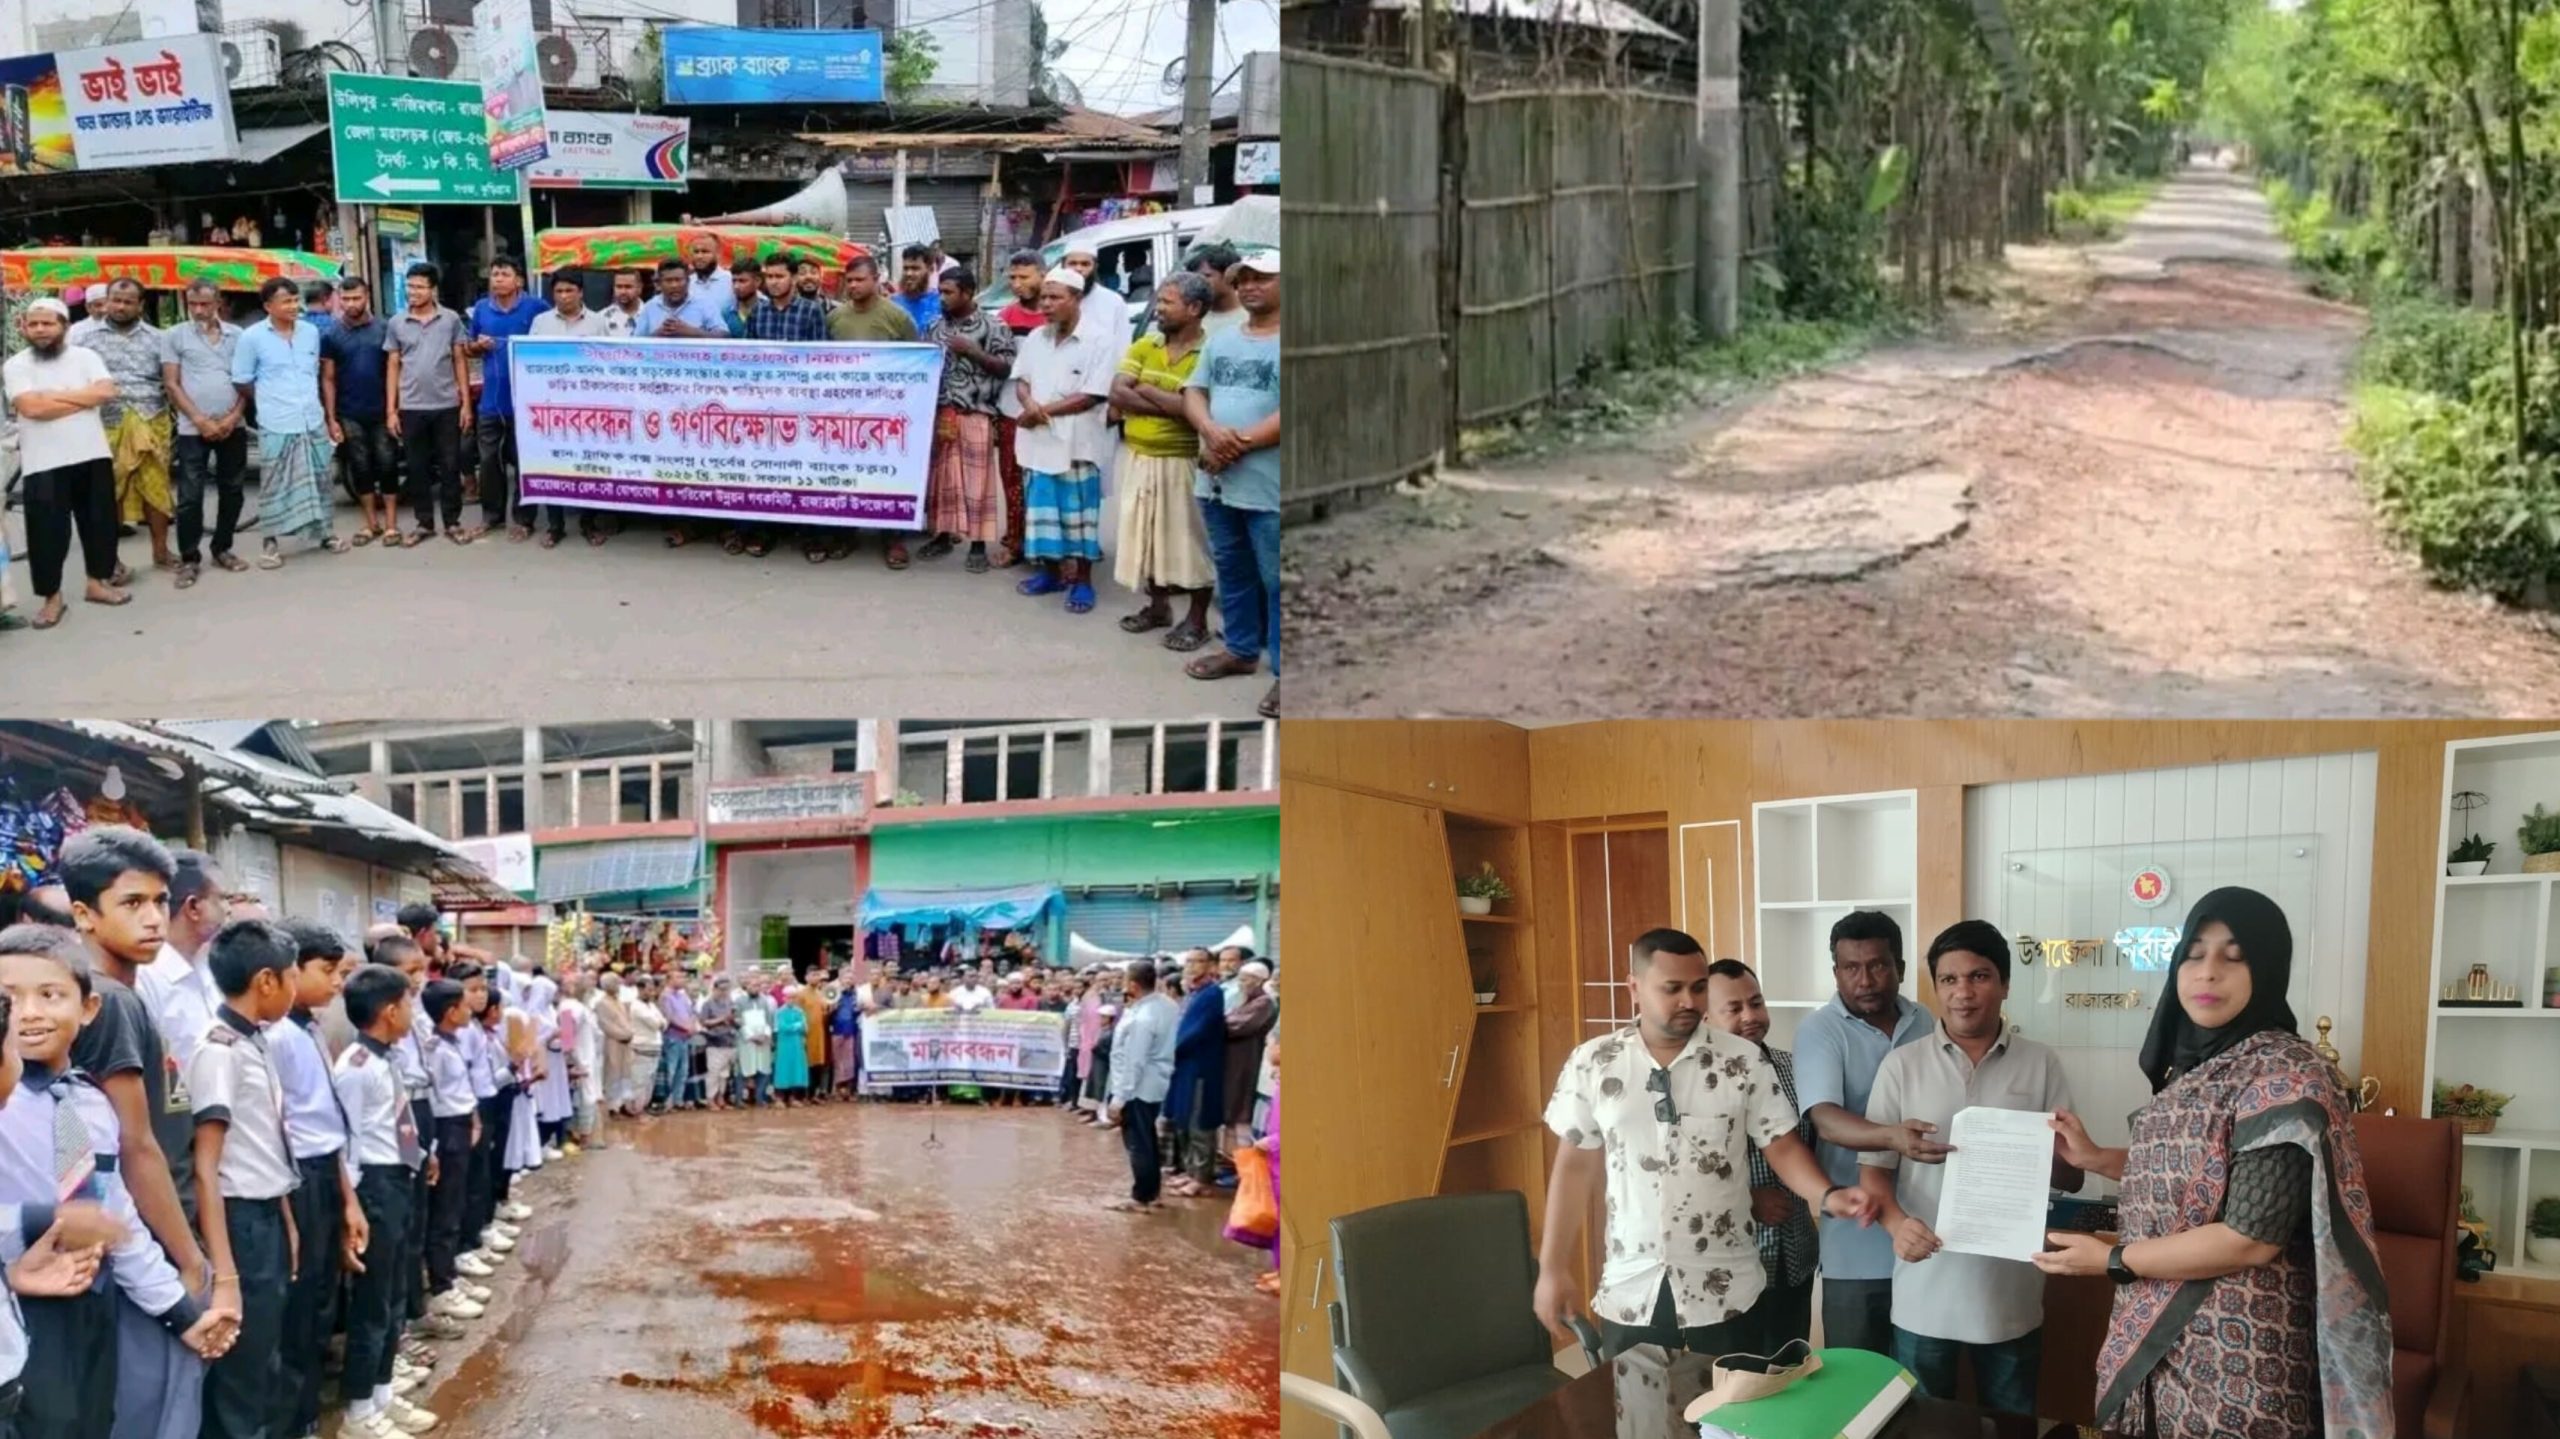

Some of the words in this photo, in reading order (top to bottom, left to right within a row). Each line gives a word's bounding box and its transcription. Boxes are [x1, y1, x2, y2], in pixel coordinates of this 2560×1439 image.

[80, 57, 128, 102] ভাই
[133, 50, 183, 96] ভাই
[741, 55, 791, 77] ব্যাংক
[334, 88, 377, 112] উলিপুর
[75, 115, 96, 130] ফল
[344, 124, 375, 140] জেলা
[379, 126, 429, 145] মহাসড়ক
[562, 130, 613, 147] ব্যাংক
[562, 147, 583, 155] FAST
[422, 154, 440, 169] ১৮
[529, 405, 634, 443] মানববন্ধন
[643, 410, 662, 441] ও
[669, 403, 799, 450] গণবিক্ষোভ
[806, 411, 911, 454] সমাবেশ
[751, 458, 803, 471] সোনালী
[807, 460, 849, 473] ব্যাংক
[755, 473, 792, 485] সকাল
[2016, 932, 2105, 969] উপজেলা
[2065, 990, 2141, 1010] রাজারহাট
[909, 1040, 1016, 1063] মনববন্ধন
